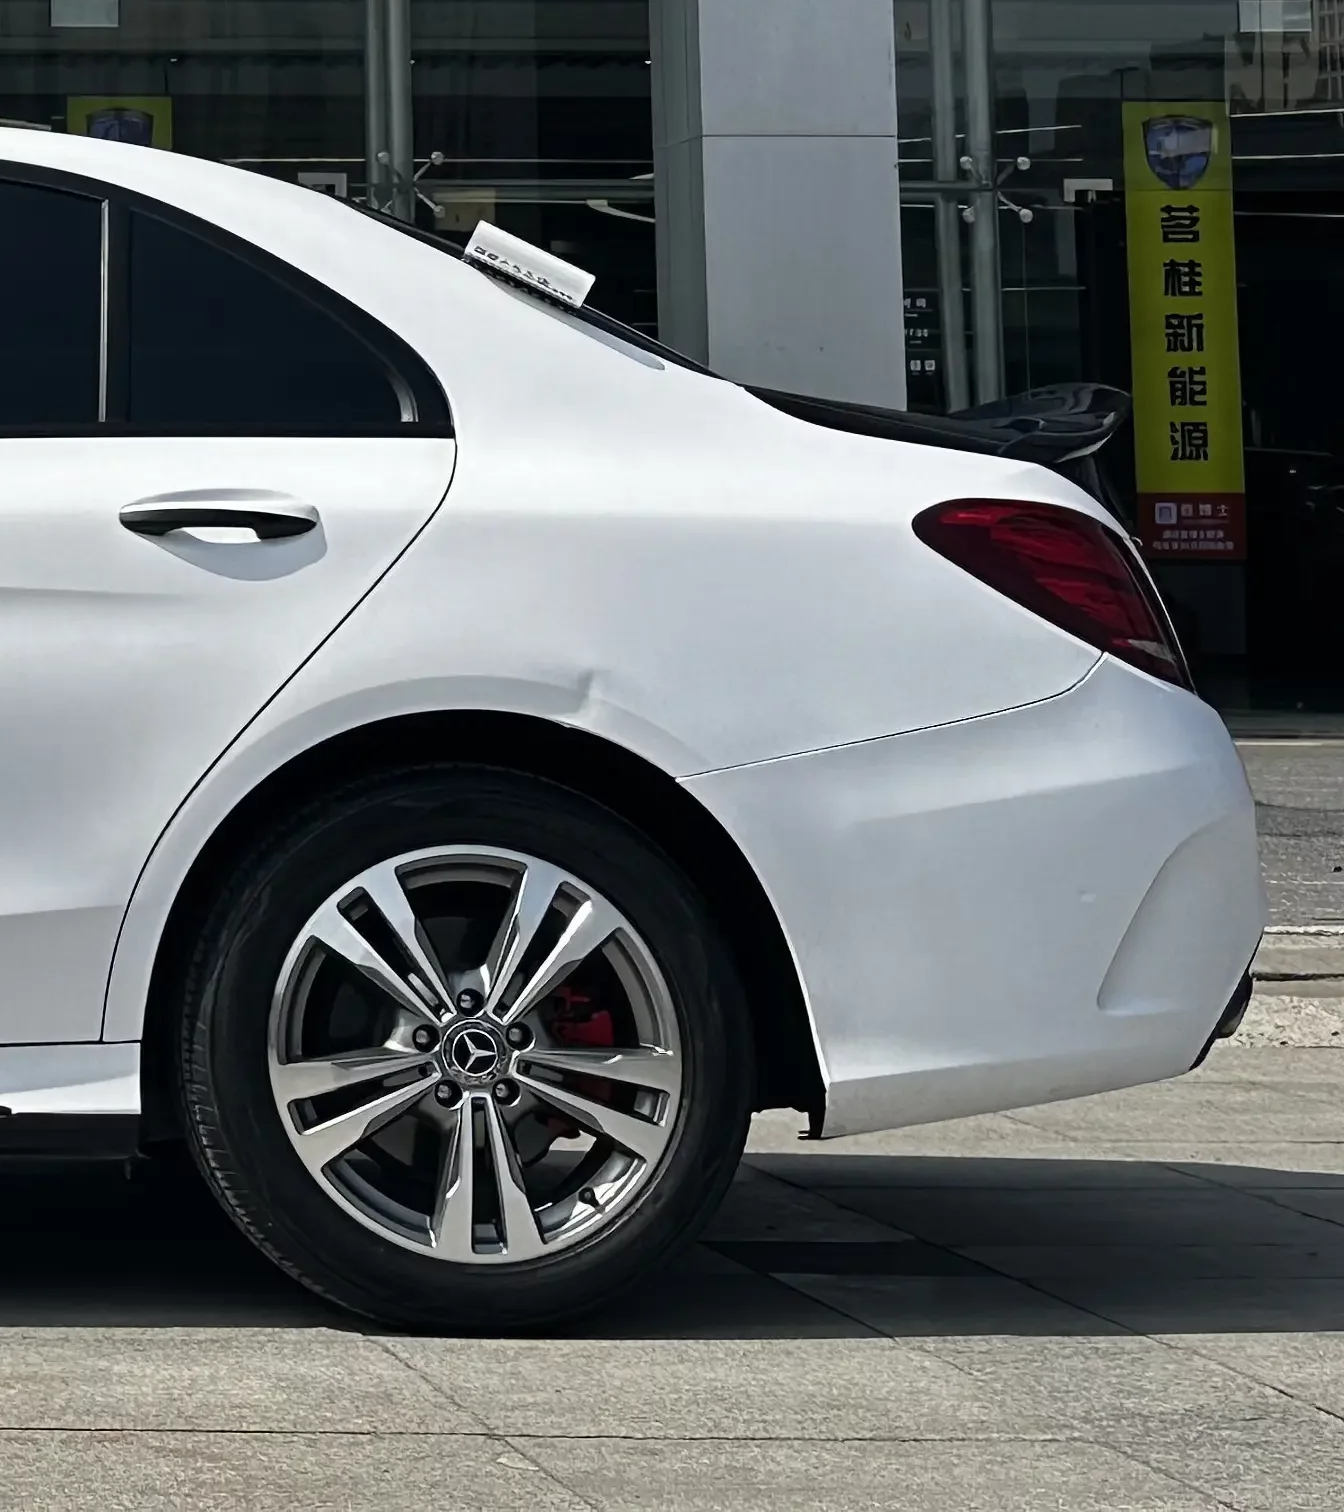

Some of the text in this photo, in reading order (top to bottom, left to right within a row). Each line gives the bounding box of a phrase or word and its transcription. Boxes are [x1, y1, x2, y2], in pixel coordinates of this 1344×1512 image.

[1160, 204, 1209, 462] 茗桂新能源
